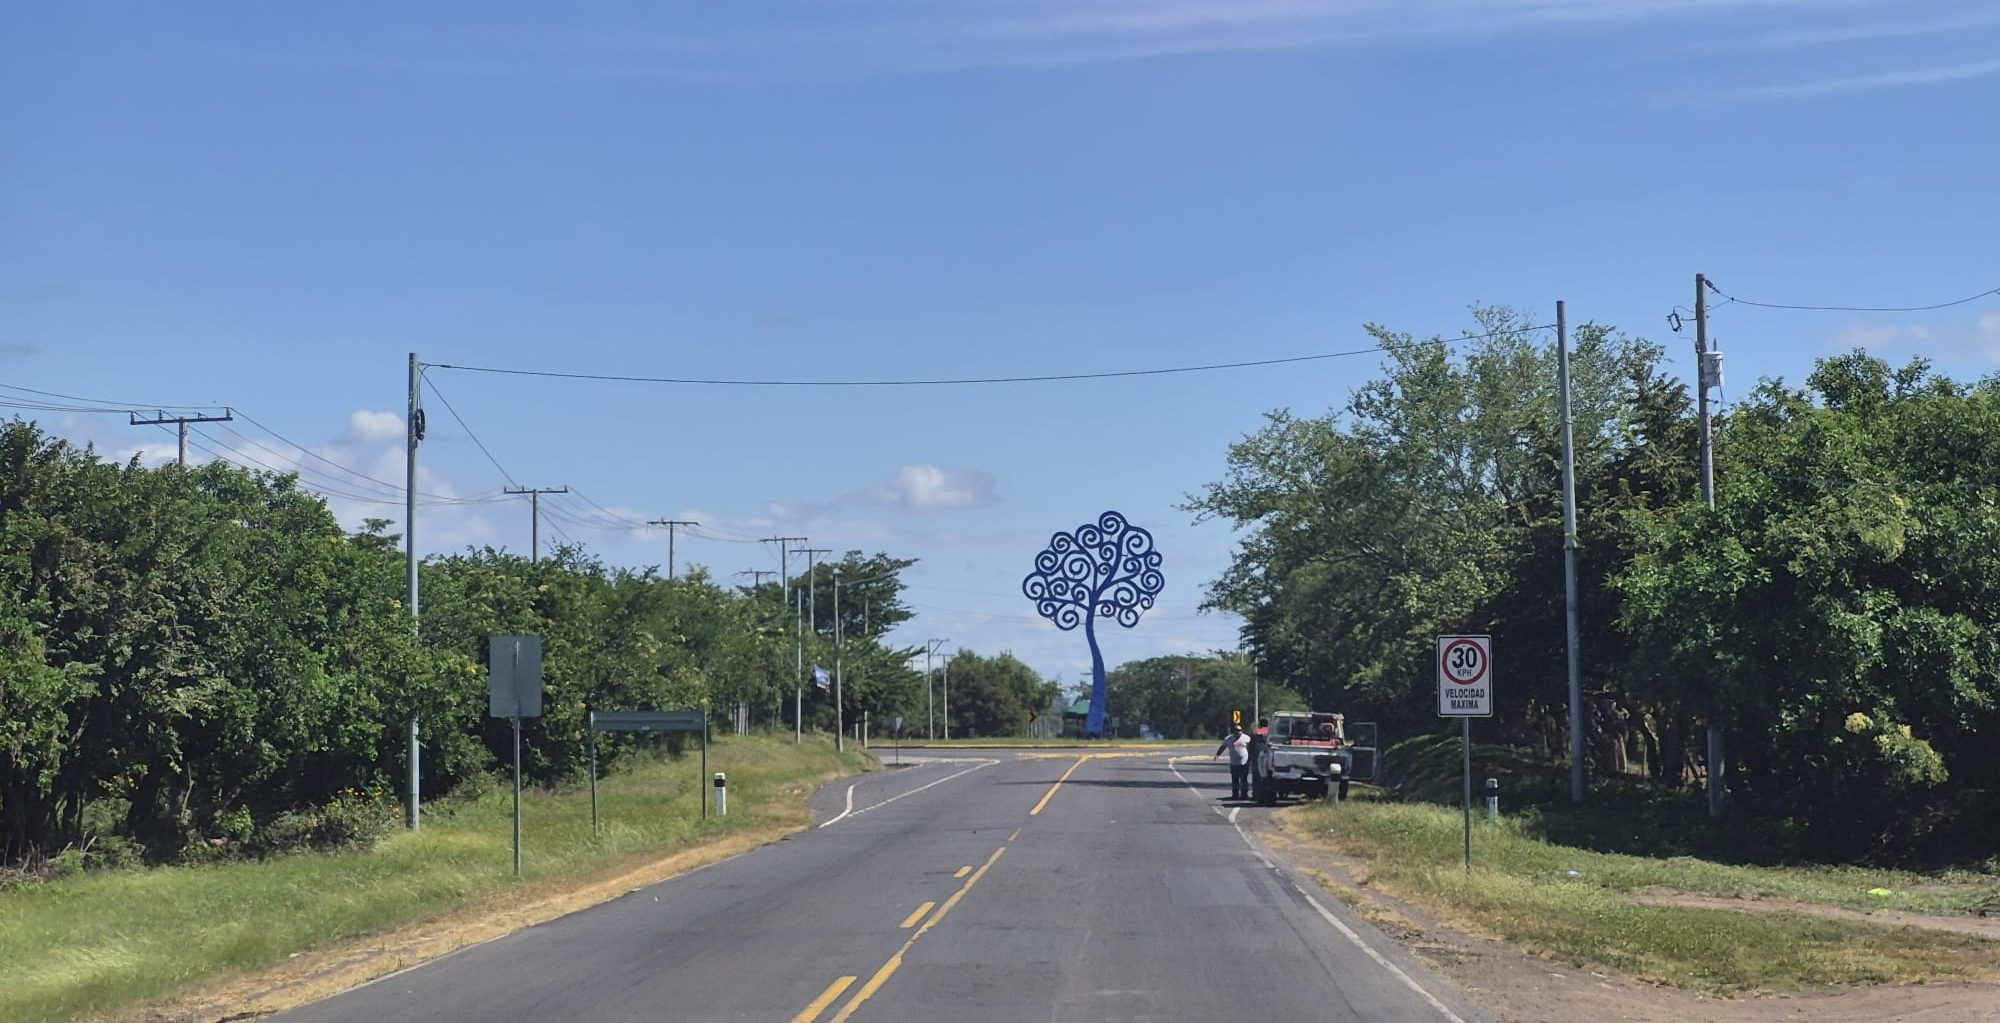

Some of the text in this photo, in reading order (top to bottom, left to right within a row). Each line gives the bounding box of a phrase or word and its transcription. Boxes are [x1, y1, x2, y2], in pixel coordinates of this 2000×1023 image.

[1452, 647, 1477, 668] 30
[1457, 669, 1472, 677] KPH
[1445, 688, 1485, 698] VELOCIDAD
[1450, 700, 1479, 709] MAXIMA
